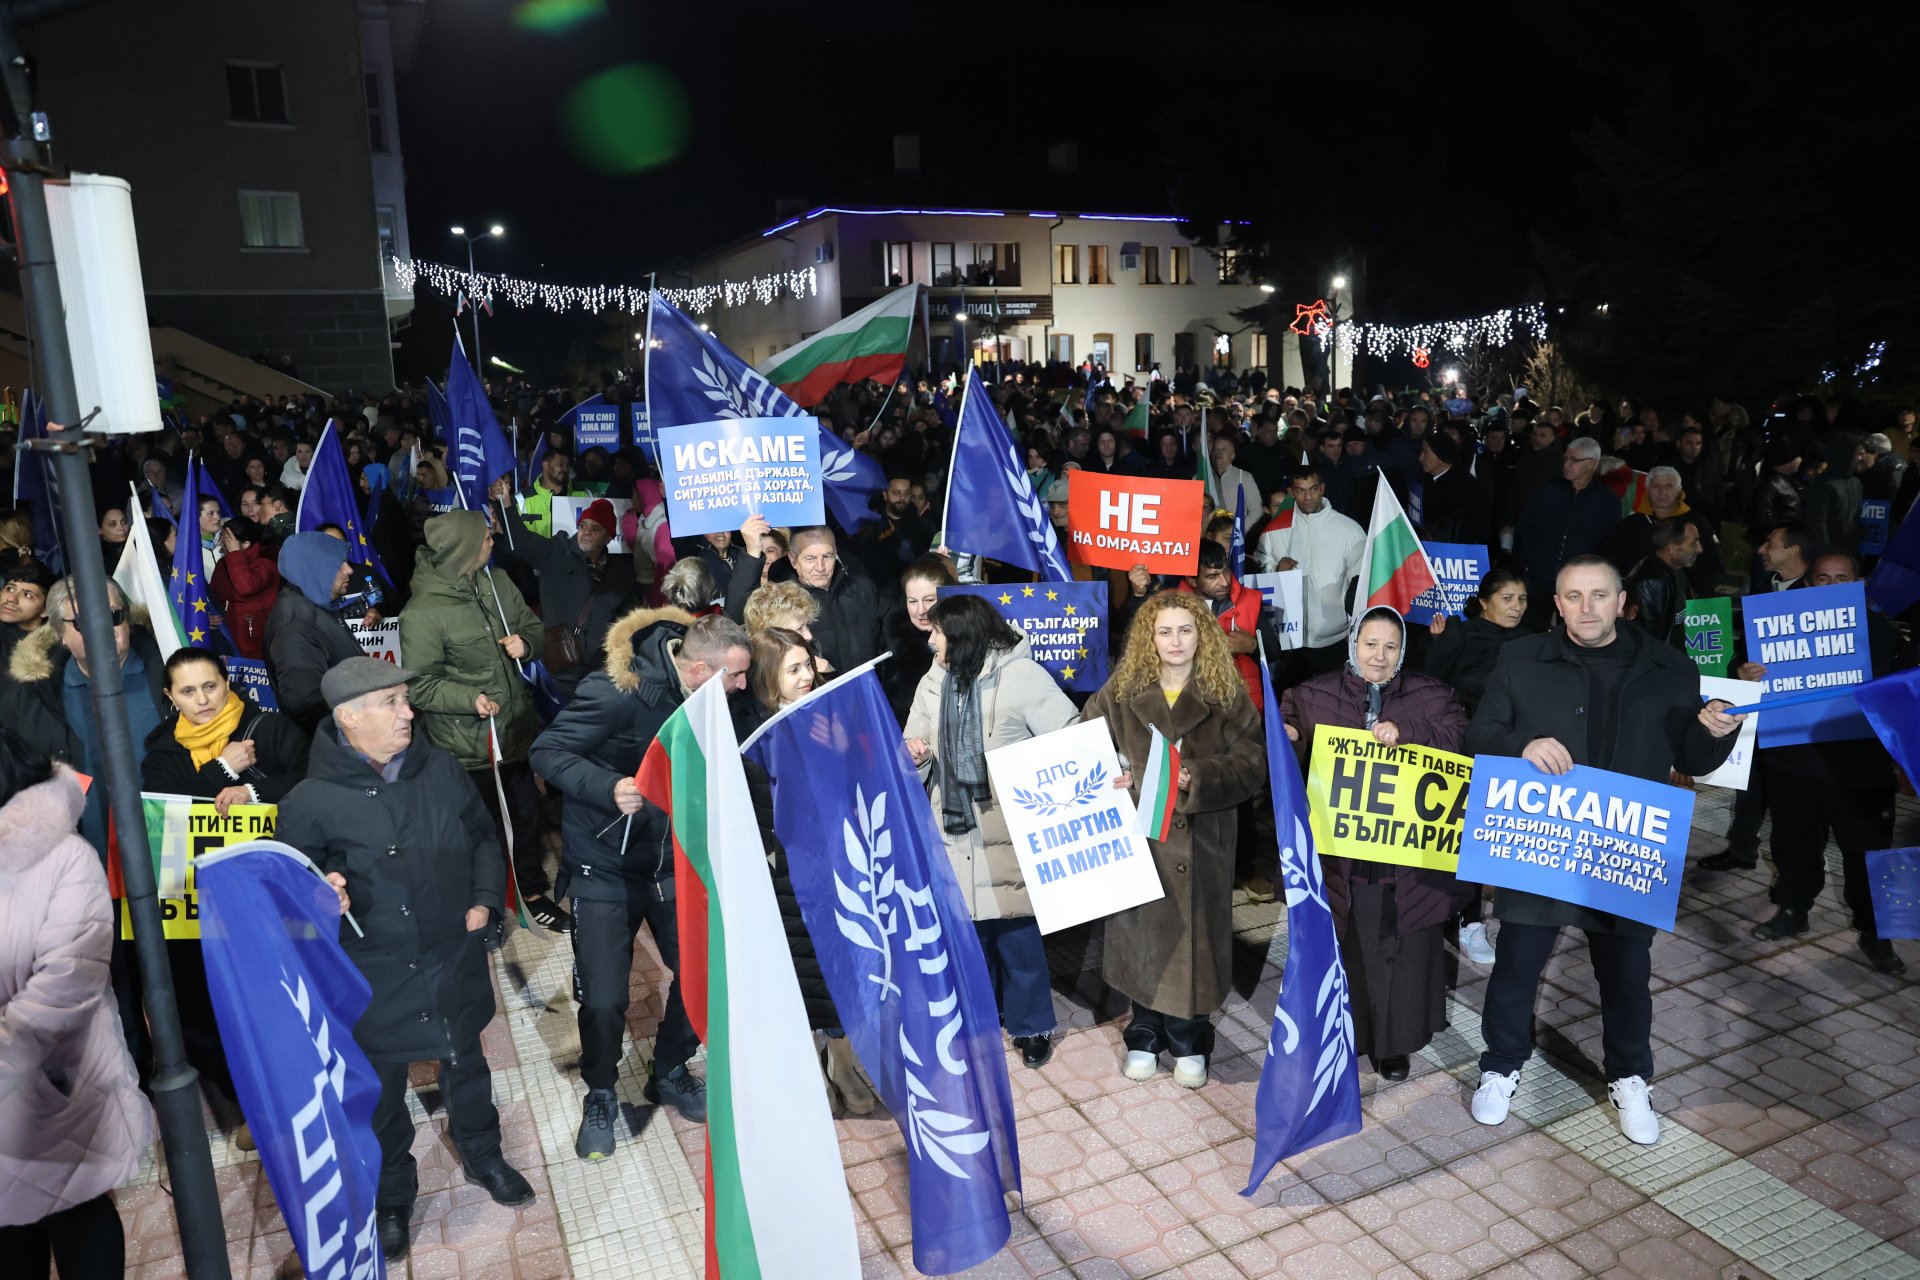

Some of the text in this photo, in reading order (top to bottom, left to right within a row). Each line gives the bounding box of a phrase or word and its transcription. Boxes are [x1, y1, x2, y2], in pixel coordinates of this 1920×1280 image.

[580, 413, 615, 422] ТУК СМЕ!
[581, 422, 614, 431] ИМА НИ!
[637, 422, 649, 431] ИМ
[674, 435, 806, 472] ИСКАМЕ
[679, 466, 810, 487] СТАБИЛНА ДЪРЖАВА,
[674, 480, 814, 501] СИГУРНОСТ ЗА ХОРАТА,
[689, 492, 804, 511] НЕ ХАОС И РАЗПАД!
[1100, 490, 1161, 535] НЕ
[1073, 530, 1190, 556] НА ОМРАЗАТА!
[1436, 583, 1480, 592] ДЪРЖАВА
[1448, 594, 1469, 602] ХОР
[1023, 617, 1098, 629] БЪЛГАРИЯ
[1273, 621, 1298, 633] АТА!
[1753, 607, 1857, 639] ТУК СМЕ!
[1028, 632, 1084, 645] ЙСКИЯТ
[1761, 633, 1855, 664] ИМА НИ!
[1034, 649, 1075, 661] НАТО!
[239, 666, 267, 676] ГРАЖД
[1773, 676, 1803, 692] СМЕ
[1806, 669, 1863, 688] СИЛНИ!
[1035, 760, 1079, 788] ДПС
[1422, 755, 1473, 780] ПАВЕТ
[1329, 757, 1471, 826] НЕ СА
[1485, 777, 1671, 844] ИСКАМЕ
[250, 816, 277, 833] ПА
[1027, 806, 1123, 855] Е ПАРТИЯ
[1484, 814, 1667, 868] СТАБИЛНА ДЪРЖАВА,
[1035, 836, 1134, 885] НА МИРА!
[1473, 827, 1668, 886] СИГУРНОСТ ЗА ХОРАТА,
[1489, 844, 1652, 895] НЕ ХАОС И РАЗПАД!
